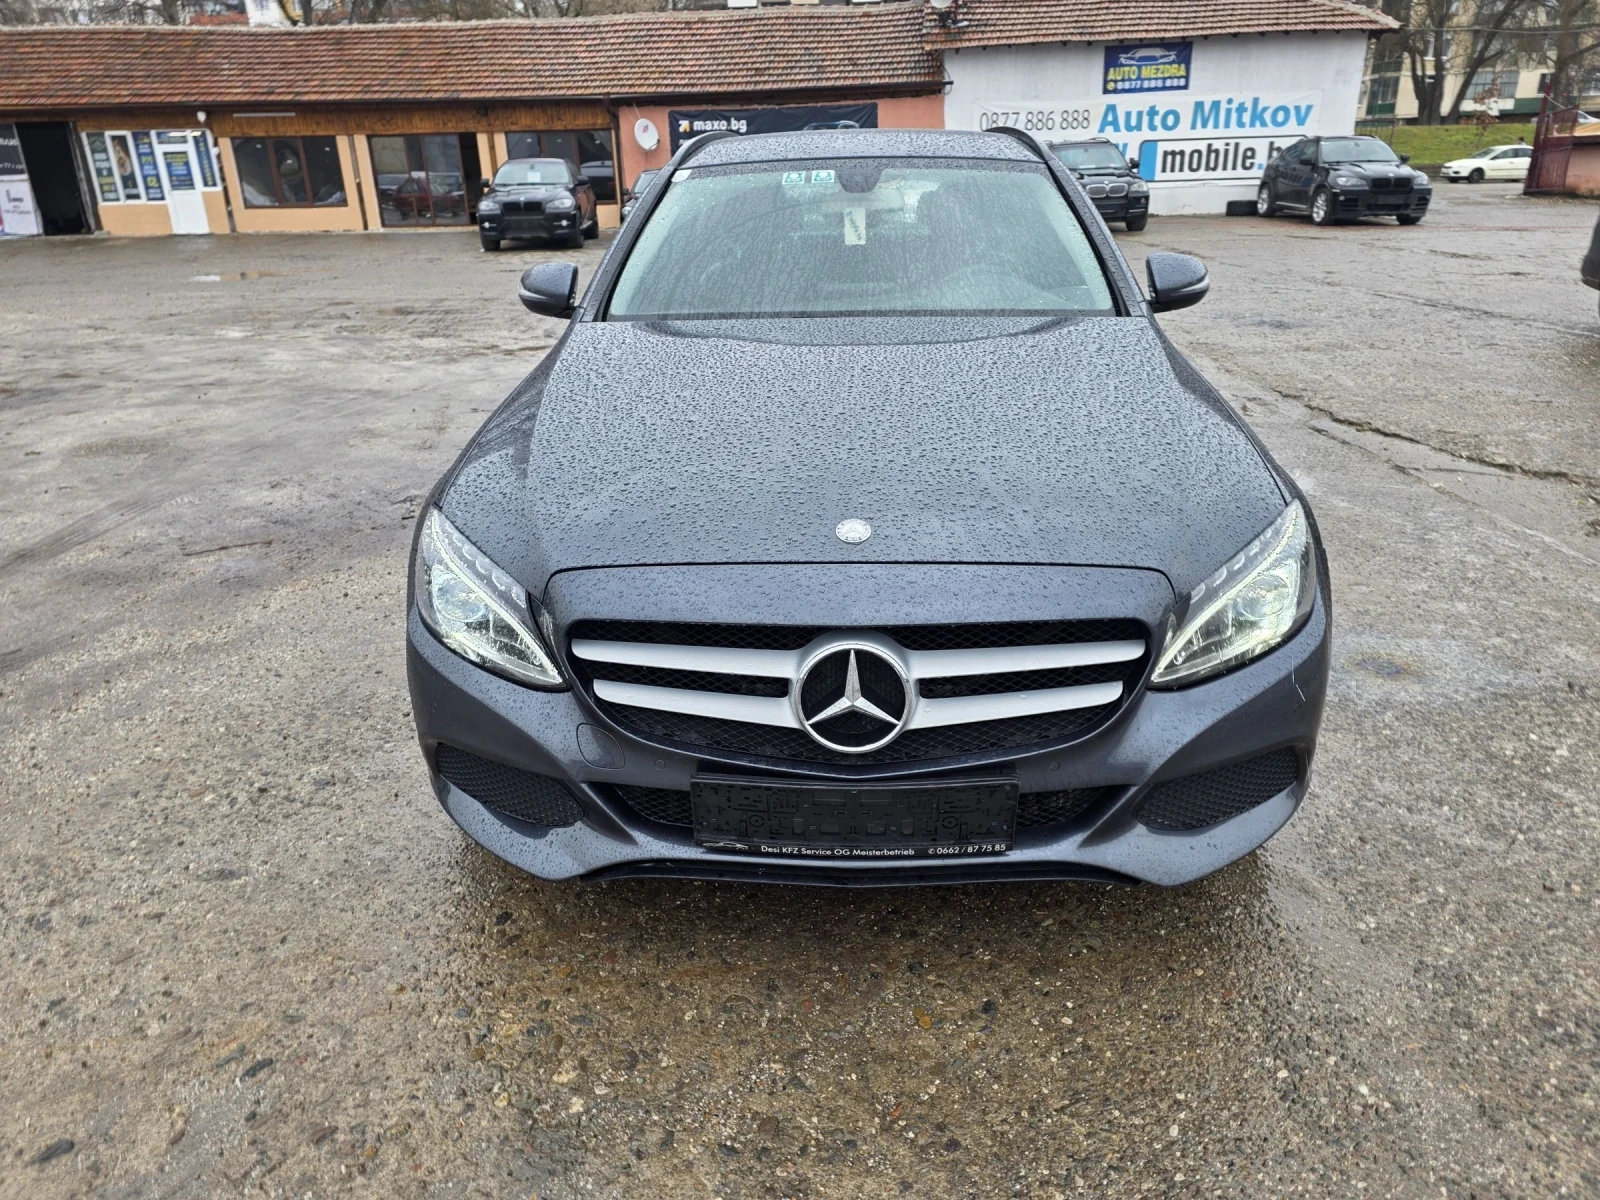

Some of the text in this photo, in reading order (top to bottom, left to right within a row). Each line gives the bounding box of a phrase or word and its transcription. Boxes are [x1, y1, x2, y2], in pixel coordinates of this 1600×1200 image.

[1107, 63, 1187, 80] AUTO MEZDRA
[980, 109, 1090, 131] 0877 886 888
[1098, 97, 1314, 134] Auto Mitkov
[693, 117, 747, 133] maxo.bg
[761, 845, 780, 853] Desi
